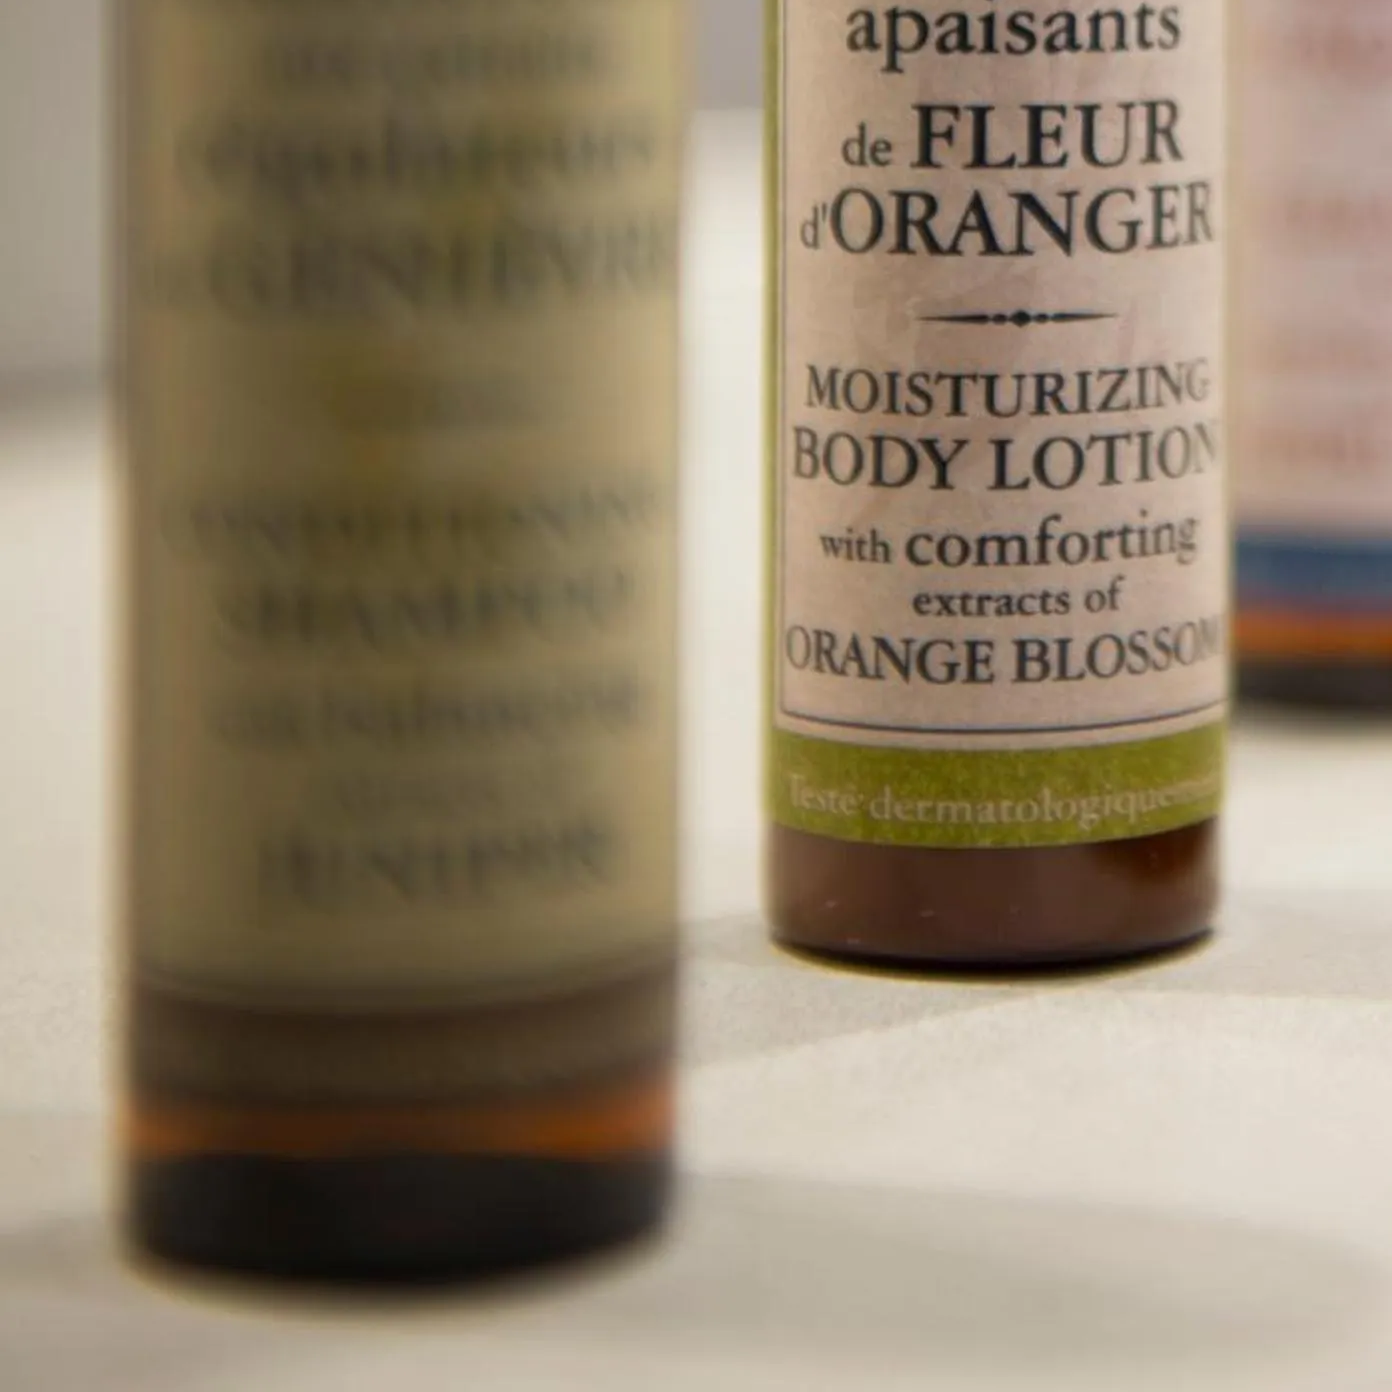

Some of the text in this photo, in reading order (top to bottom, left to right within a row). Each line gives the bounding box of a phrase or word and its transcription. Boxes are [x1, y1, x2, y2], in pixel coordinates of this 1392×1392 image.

[841, 99, 1185, 169] de FLEUR
[800, 181, 1215, 257] d'ORANGER
[805, 357, 1210, 418] MOISTURIZING
[791, 425, 971, 490] BODY
[987, 417, 1219, 490] LOTION
[820, 509, 1200, 568] with comforting
[913, 575, 1126, 617] extracts of
[785, 625, 995, 685] ORANGE
